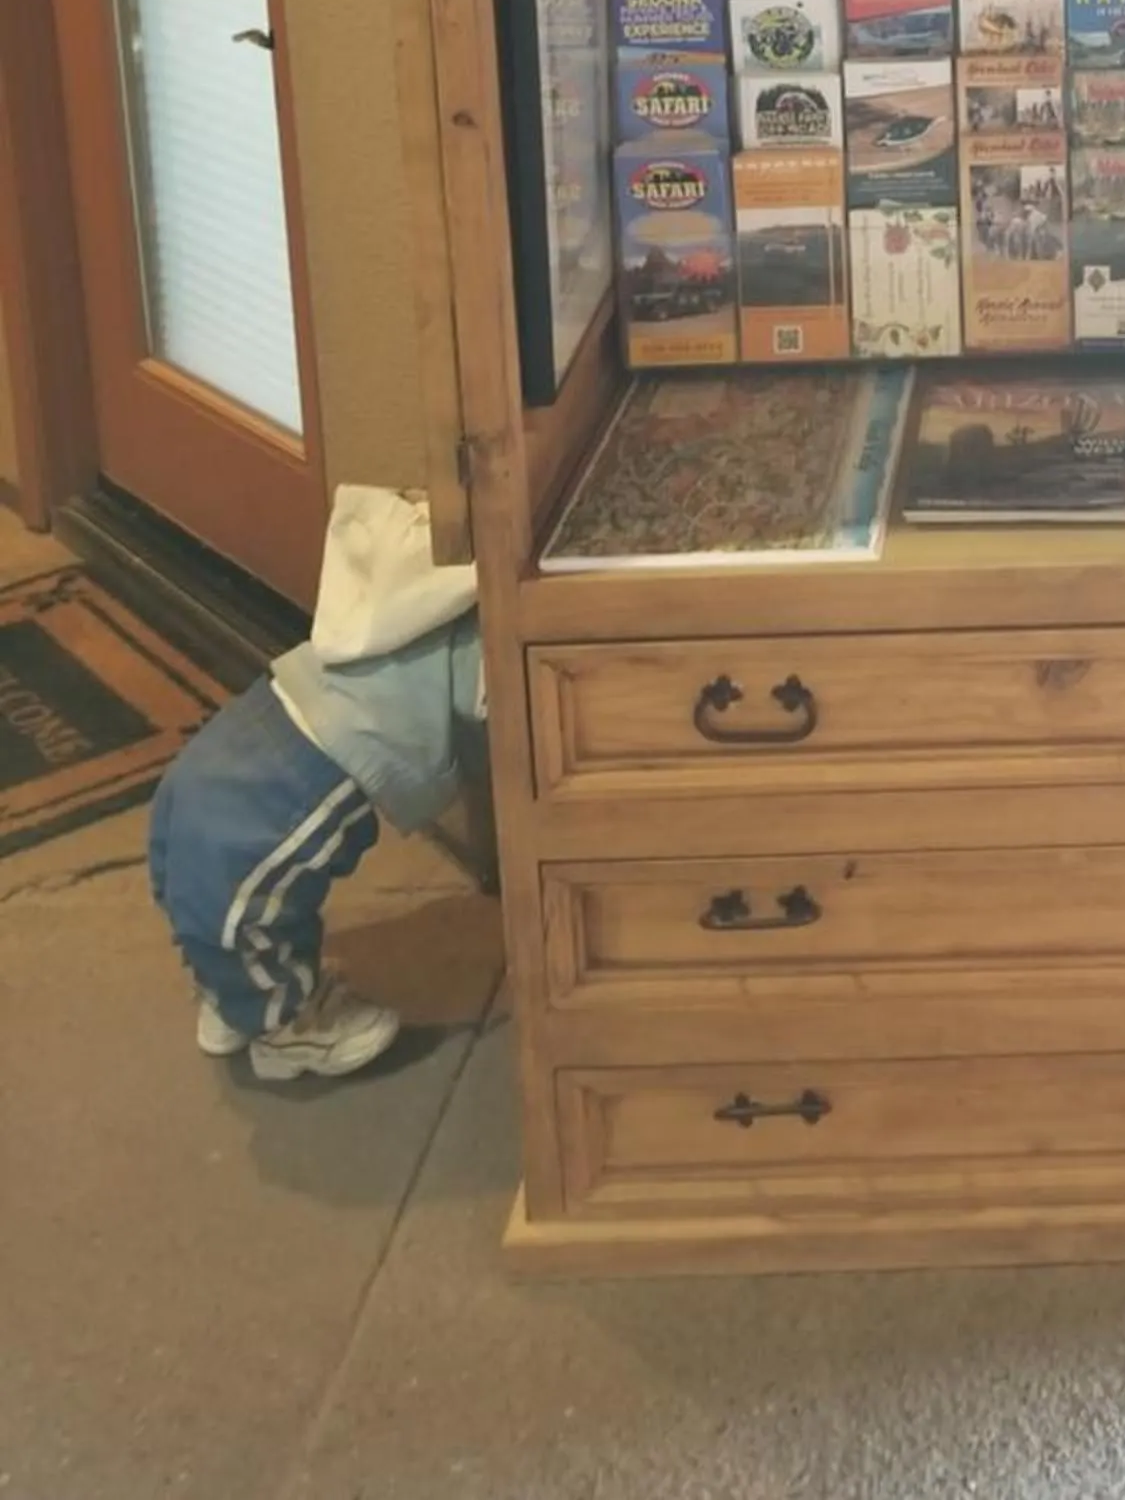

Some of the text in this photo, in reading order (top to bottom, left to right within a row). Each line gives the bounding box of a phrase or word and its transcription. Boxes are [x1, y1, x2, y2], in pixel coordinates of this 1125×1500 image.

[623, 22, 712, 38] EXPERIENCE
[634, 95, 710, 116] SAFARI
[631, 180, 706, 199] SAFARI
